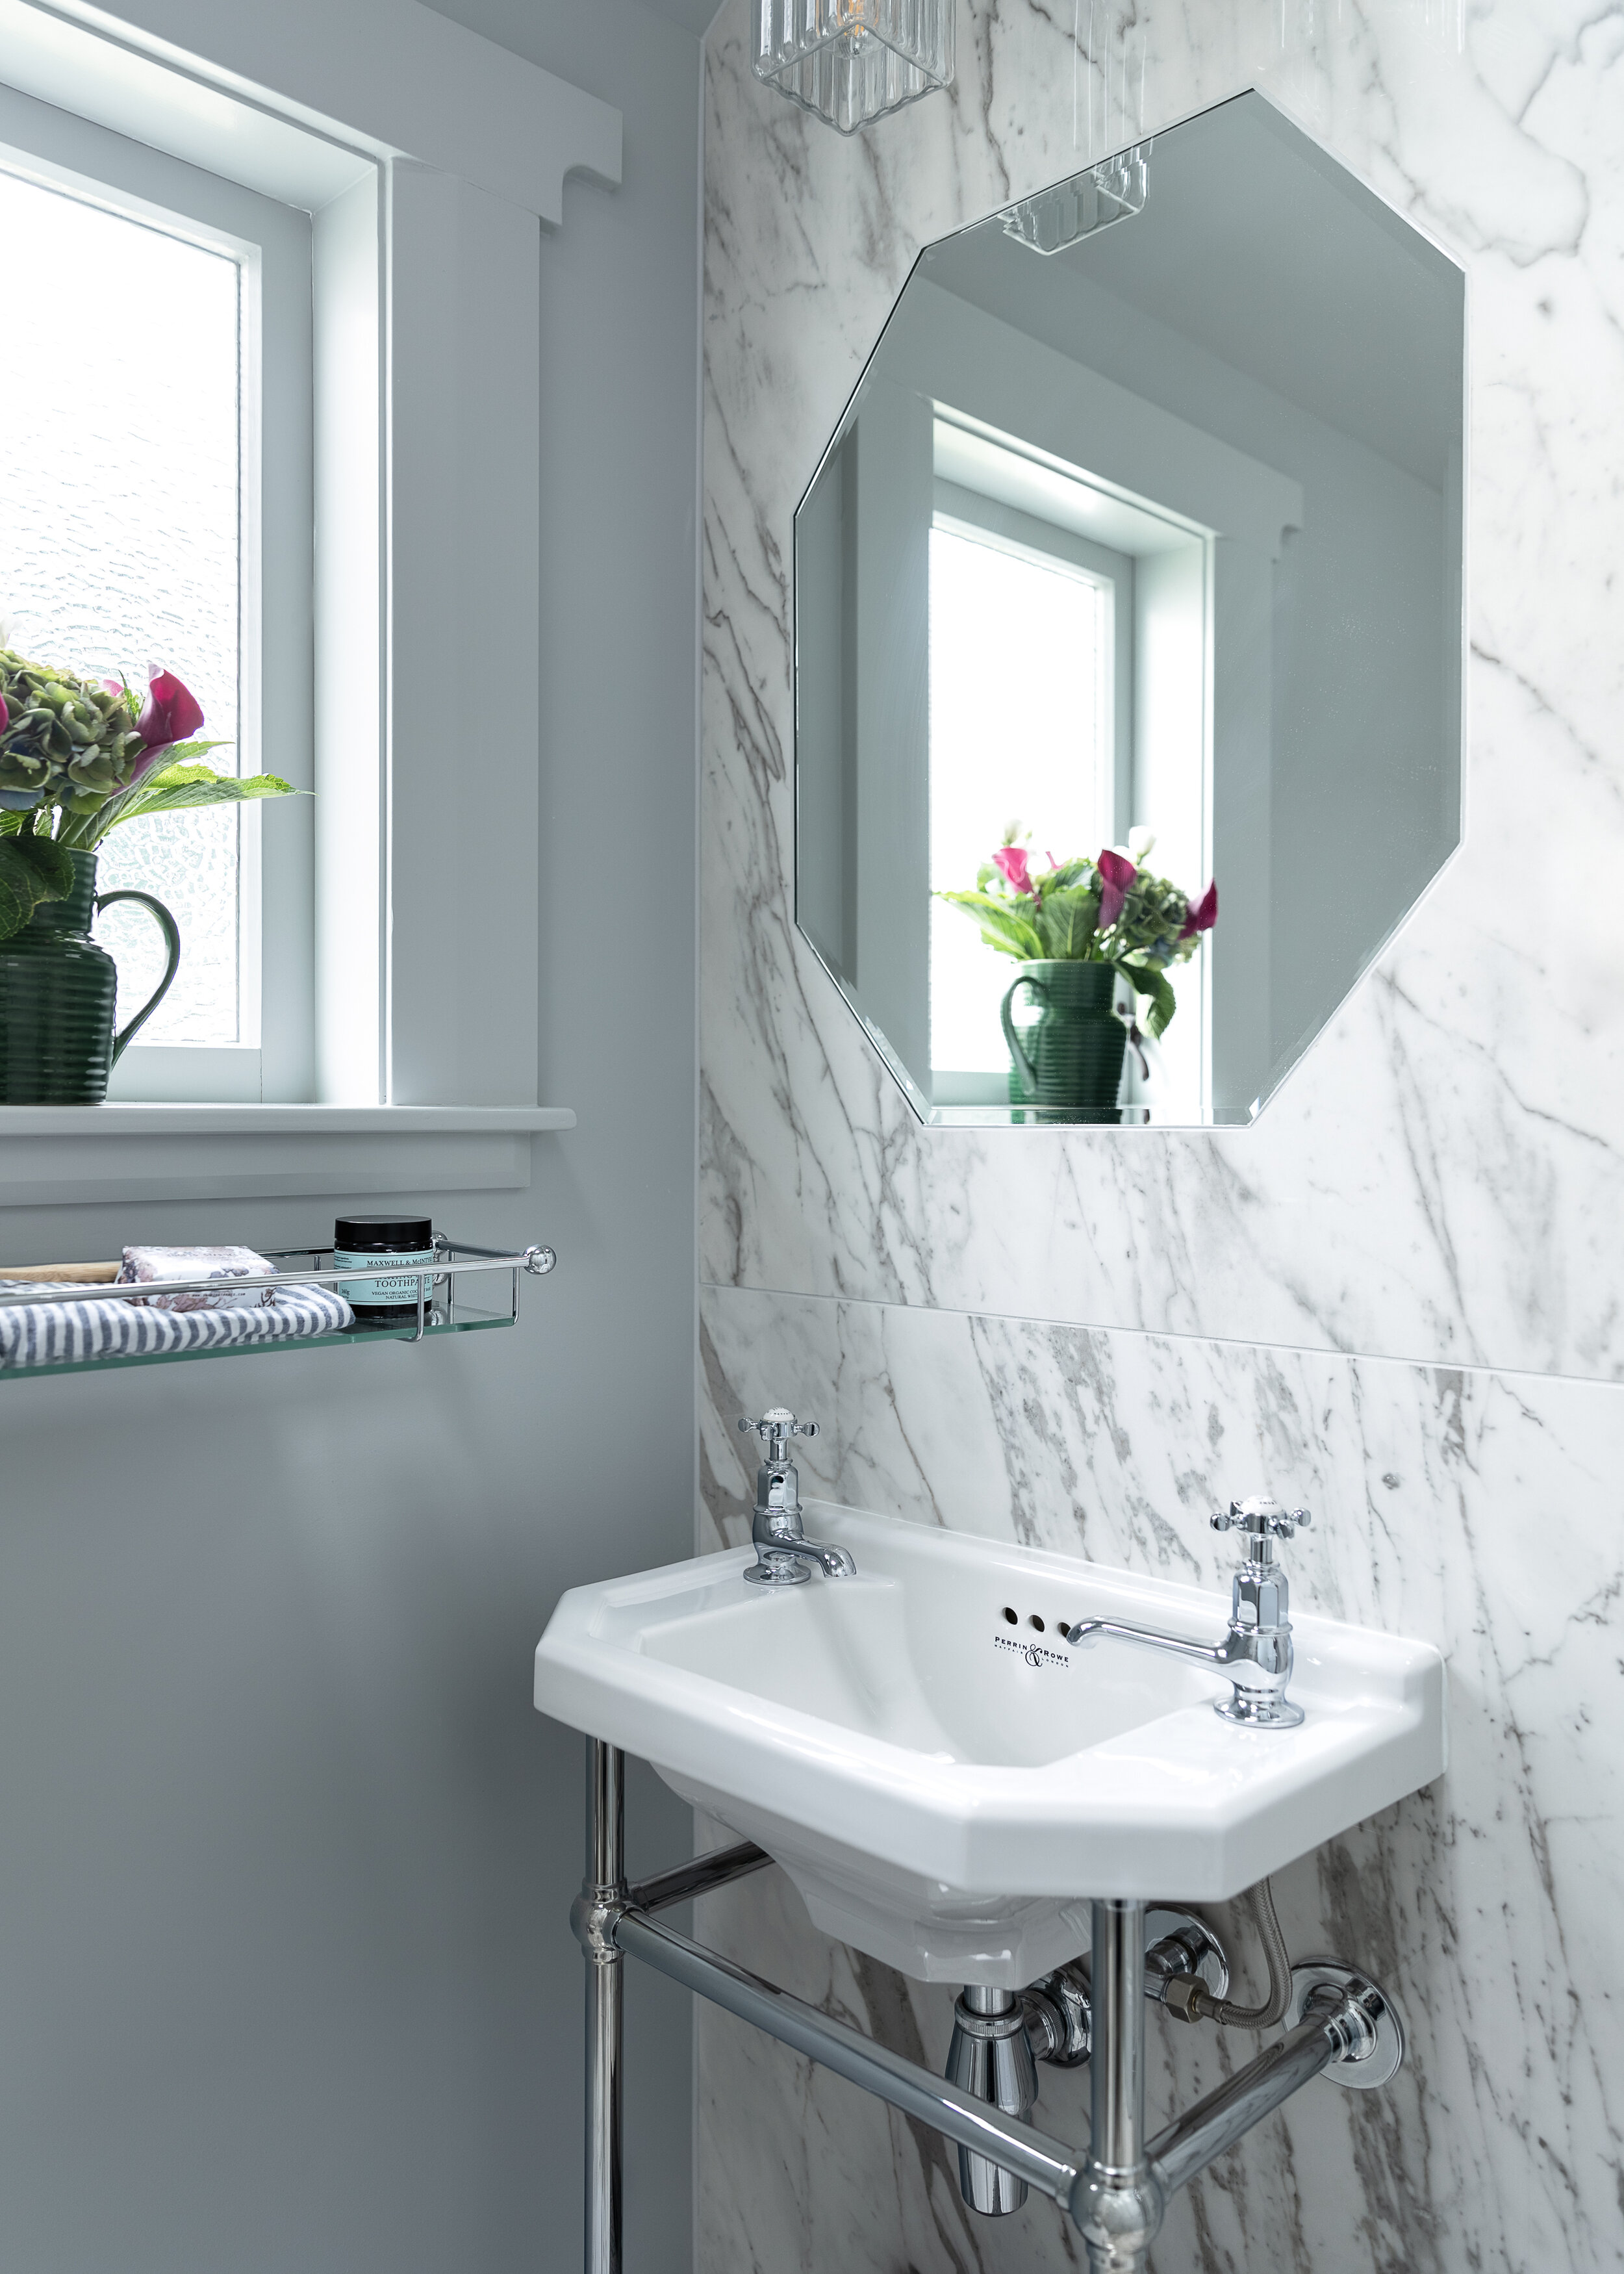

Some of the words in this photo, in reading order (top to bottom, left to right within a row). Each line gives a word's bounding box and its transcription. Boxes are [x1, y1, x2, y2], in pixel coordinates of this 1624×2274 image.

[375, 1276, 430, 1288] TOOTHPATE
[995, 1637, 1027, 1650] PERRIN
[1044, 1650, 1069, 1663] ROWE
[1041, 1657, 1069, 1668] LONDON
